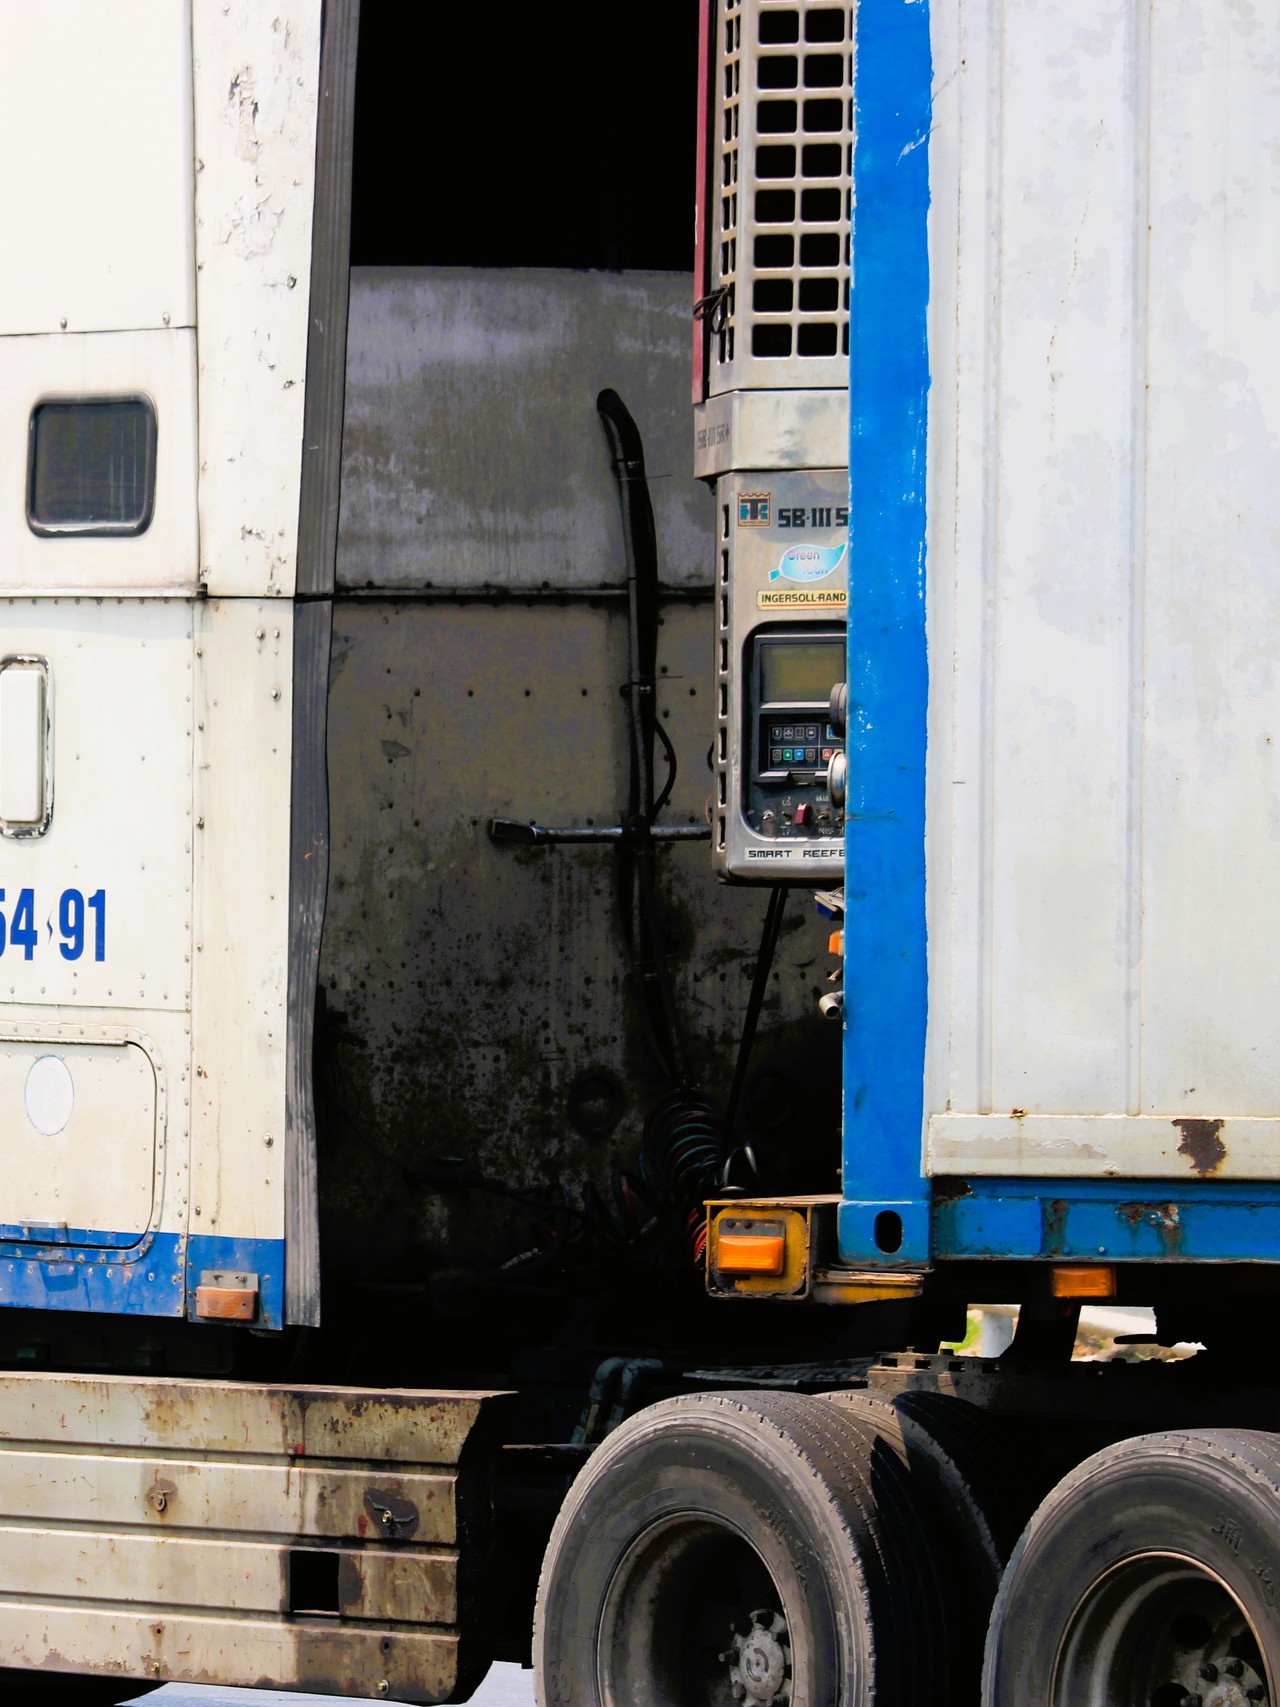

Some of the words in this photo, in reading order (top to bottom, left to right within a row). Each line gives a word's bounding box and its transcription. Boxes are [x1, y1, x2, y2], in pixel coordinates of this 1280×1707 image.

[835, 507, 848, 527] S
[787, 549, 820, 560] Green
[761, 593, 847, 603] INGERSOLL-RAND
[748, 850, 792, 858] SMART
[59, 888, 106, 962] 91
